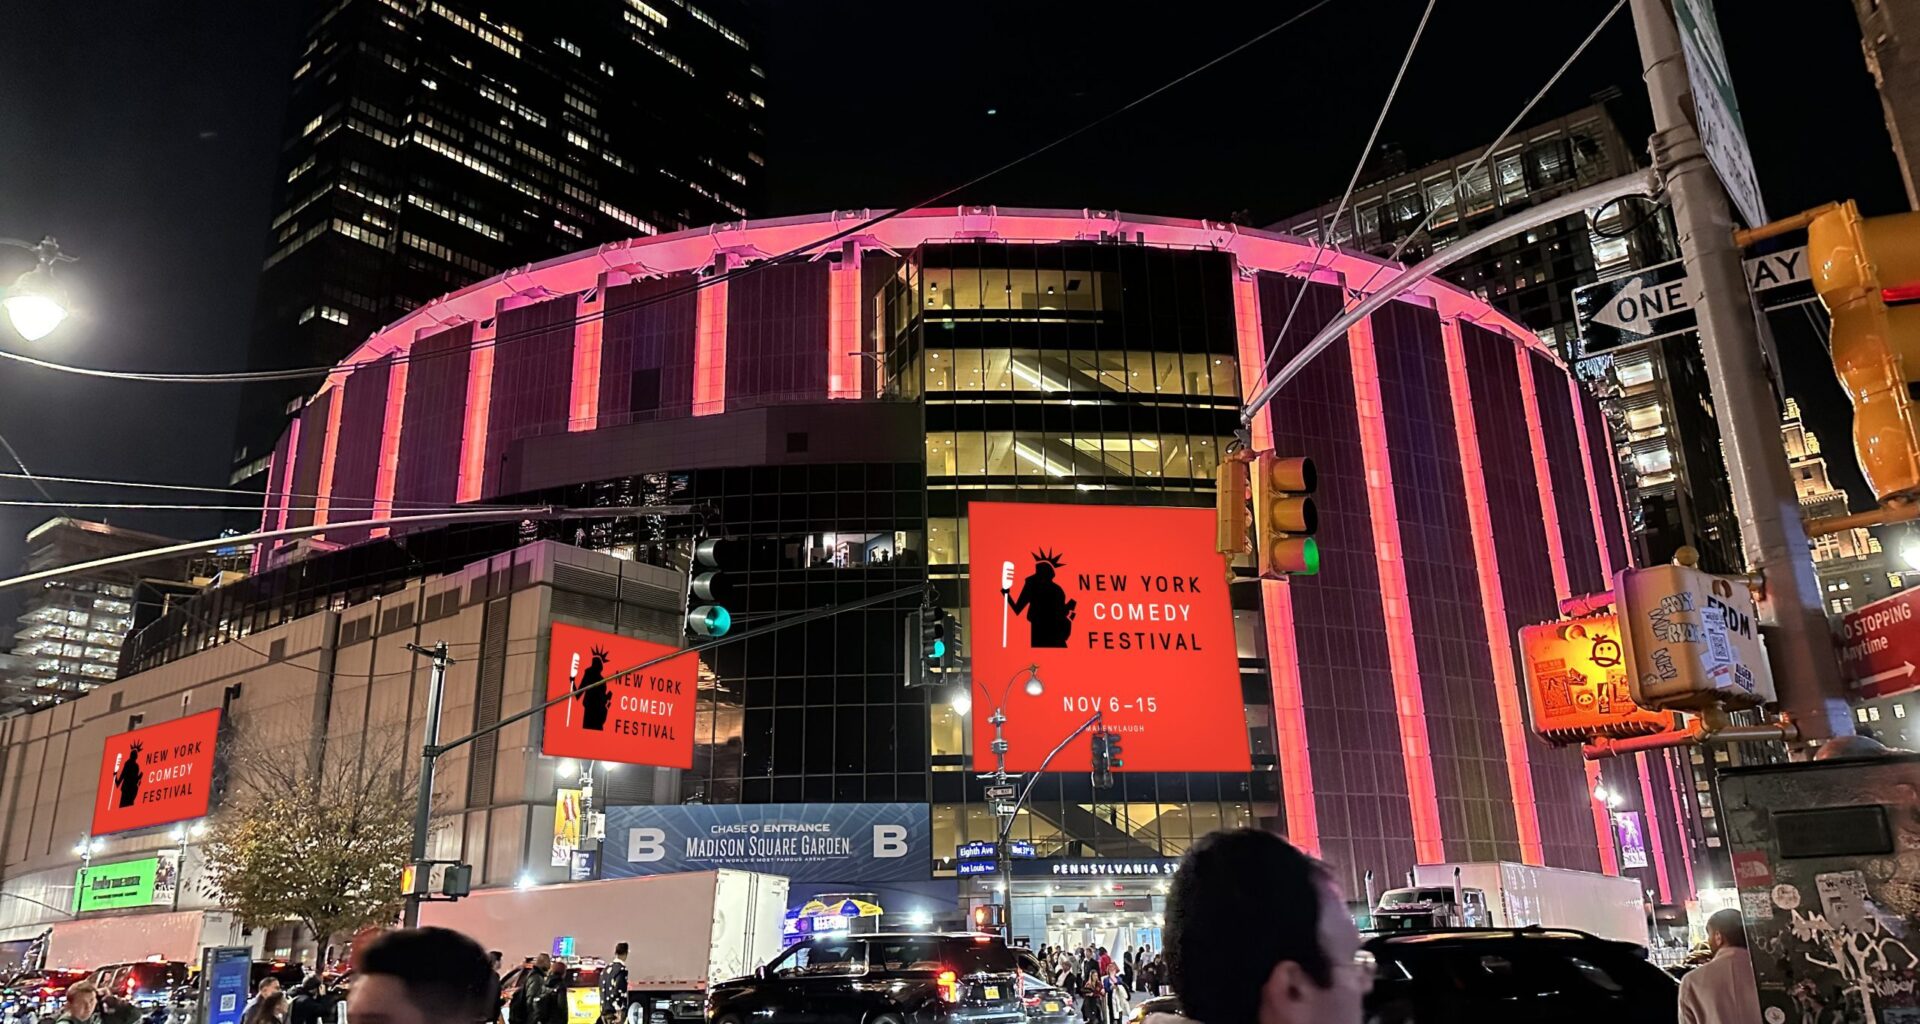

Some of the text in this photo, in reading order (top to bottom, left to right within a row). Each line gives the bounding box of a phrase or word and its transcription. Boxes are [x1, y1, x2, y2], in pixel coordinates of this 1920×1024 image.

[1616, 251, 1801, 324] ONE AY
[1078, 574, 1201, 593] NEW YORK
[1093, 602, 1191, 622] COMEDY
[1854, 602, 1912, 636] STOPPING
[1088, 631, 1202, 651] FESTIVAL
[1842, 636, 1889, 661] Anytime
[614, 670, 682, 696] NEW YORK
[620, 695, 675, 717] COMEDY
[1063, 696, 1102, 713] NOV
[614, 719, 676, 741] FESTIVAL
[145, 741, 202, 764] NEW YORK
[148, 763, 193, 783] COMEDY
[142, 782, 193, 803] FESTIVAL
[711, 823, 831, 834] CHASE ENTRANCE
[627, 827, 666, 863] B
[686, 837, 745, 858] MADISON
[749, 835, 798, 857] SQUARE
[873, 824, 908, 858] B
[960, 847, 994, 858] Eighth Ave
[960, 865, 970, 873] Joe
[970, 864, 985, 873] Louis
[1052, 863, 1159, 875] PENNSYLVANIA
